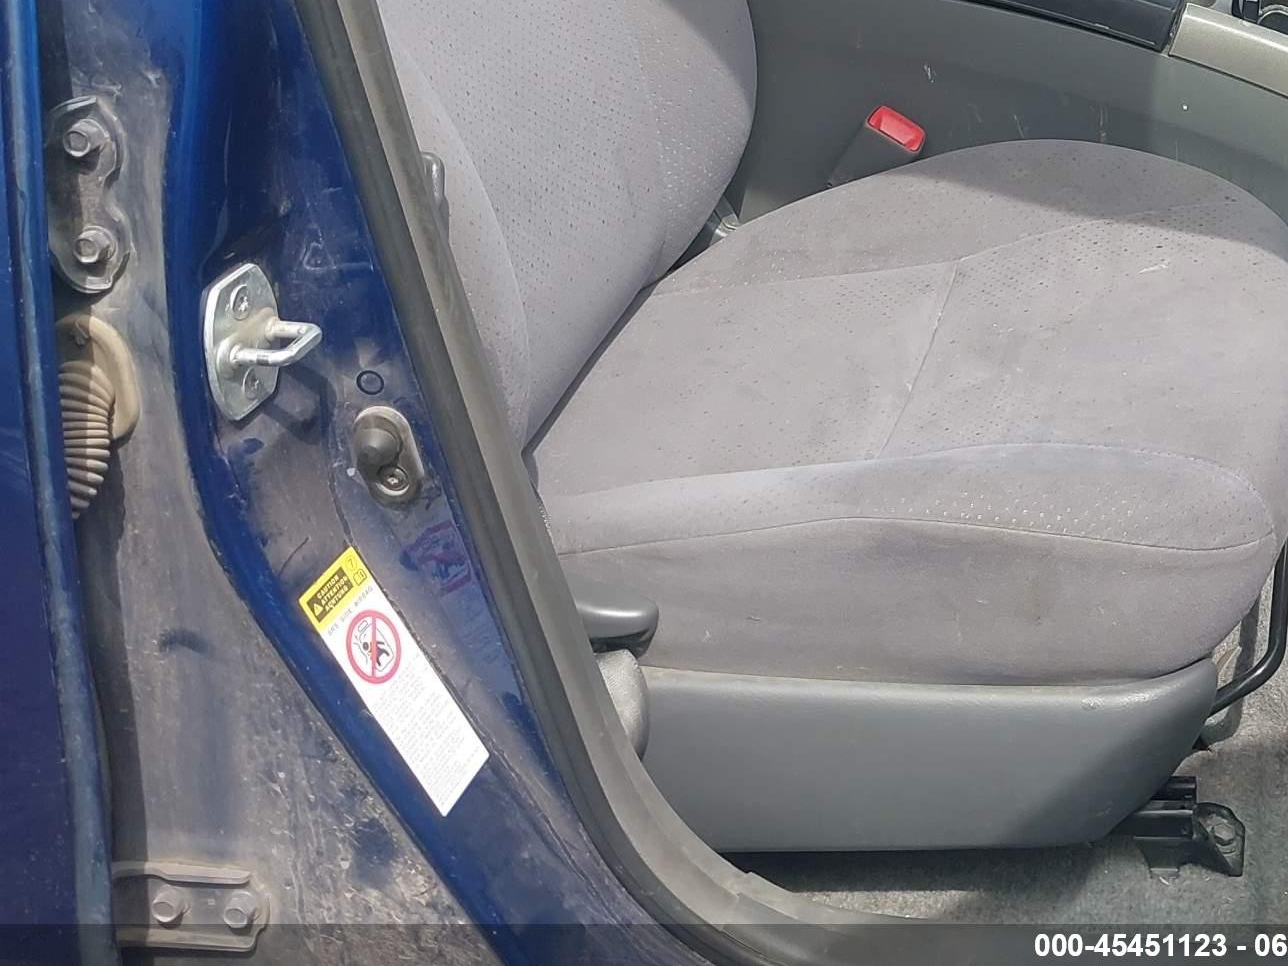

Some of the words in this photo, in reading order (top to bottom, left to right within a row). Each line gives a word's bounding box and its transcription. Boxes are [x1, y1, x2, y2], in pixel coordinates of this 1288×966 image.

[316, 574, 341, 600] CAUTION
[320, 575, 349, 607] ATTENTION
[324, 585, 349, 613] ACHTUNG
